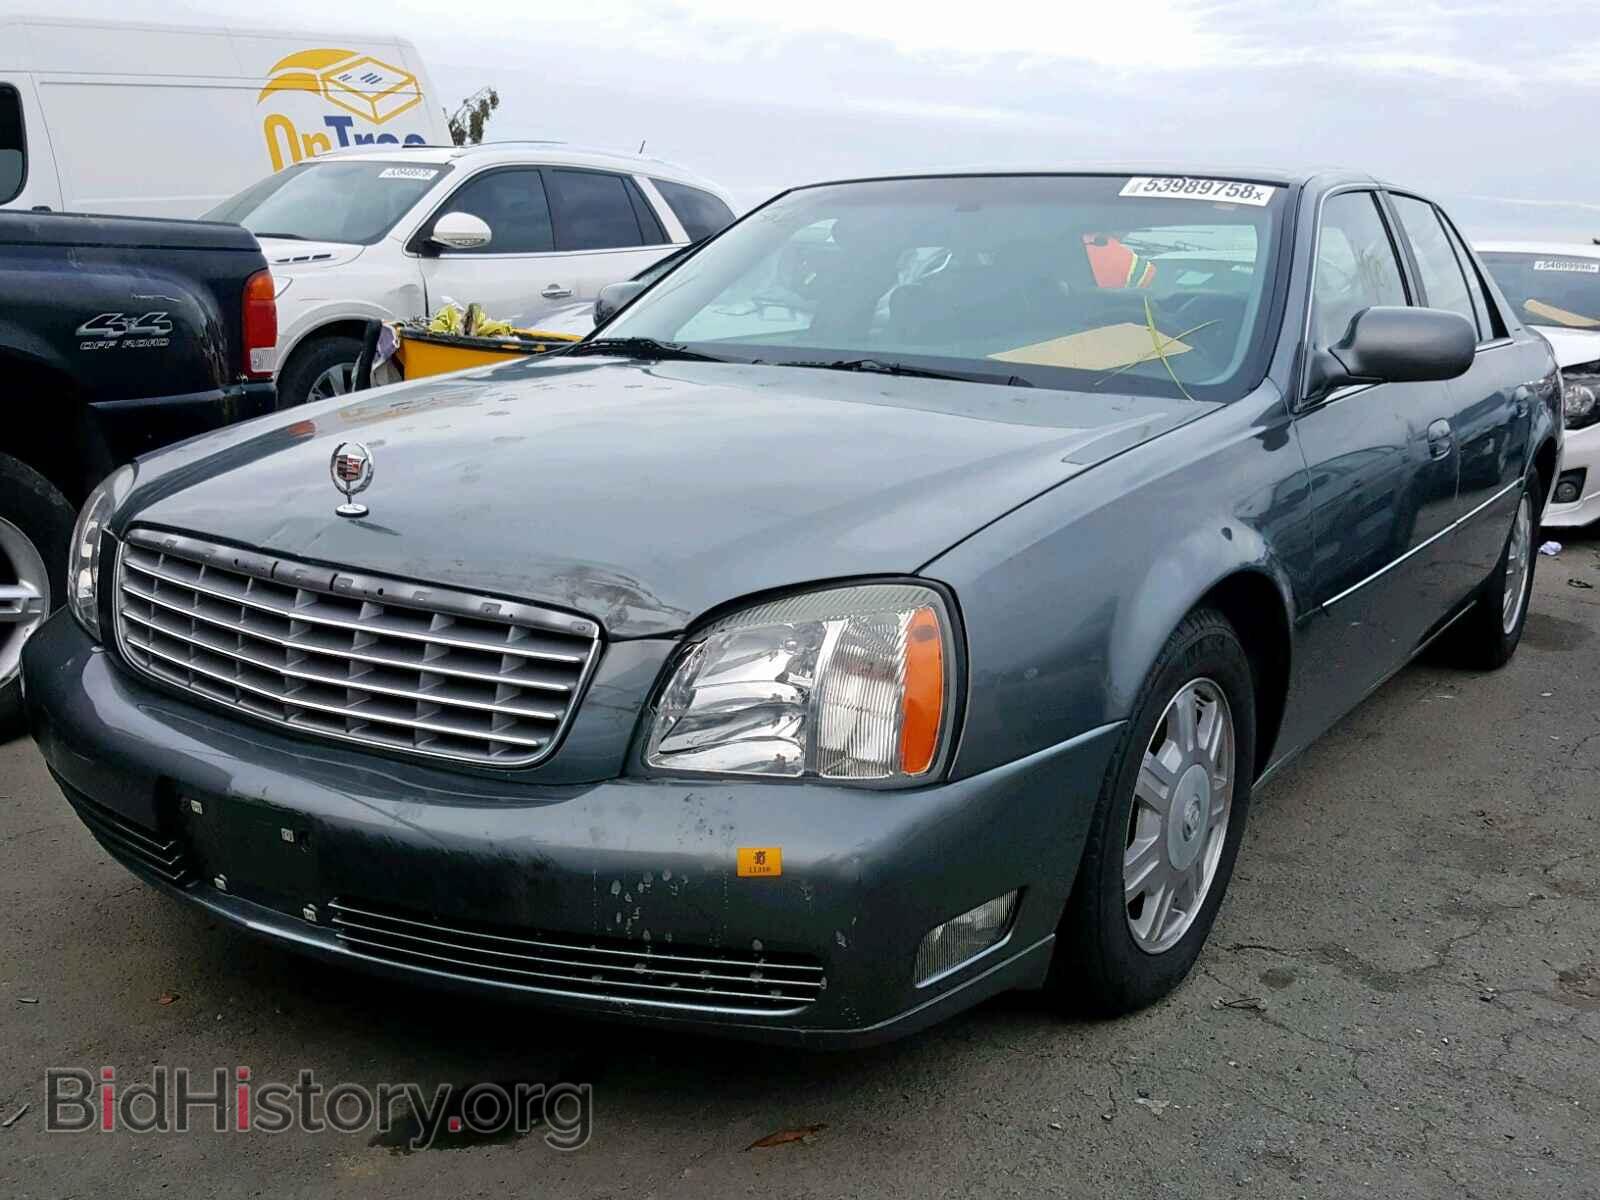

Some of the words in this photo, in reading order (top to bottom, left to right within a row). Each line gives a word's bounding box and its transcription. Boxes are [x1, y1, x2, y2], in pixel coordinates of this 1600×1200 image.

[264, 114, 426, 172] OnTr
[80, 341, 117, 350] OFF
[121, 338, 170, 348] ROAD
